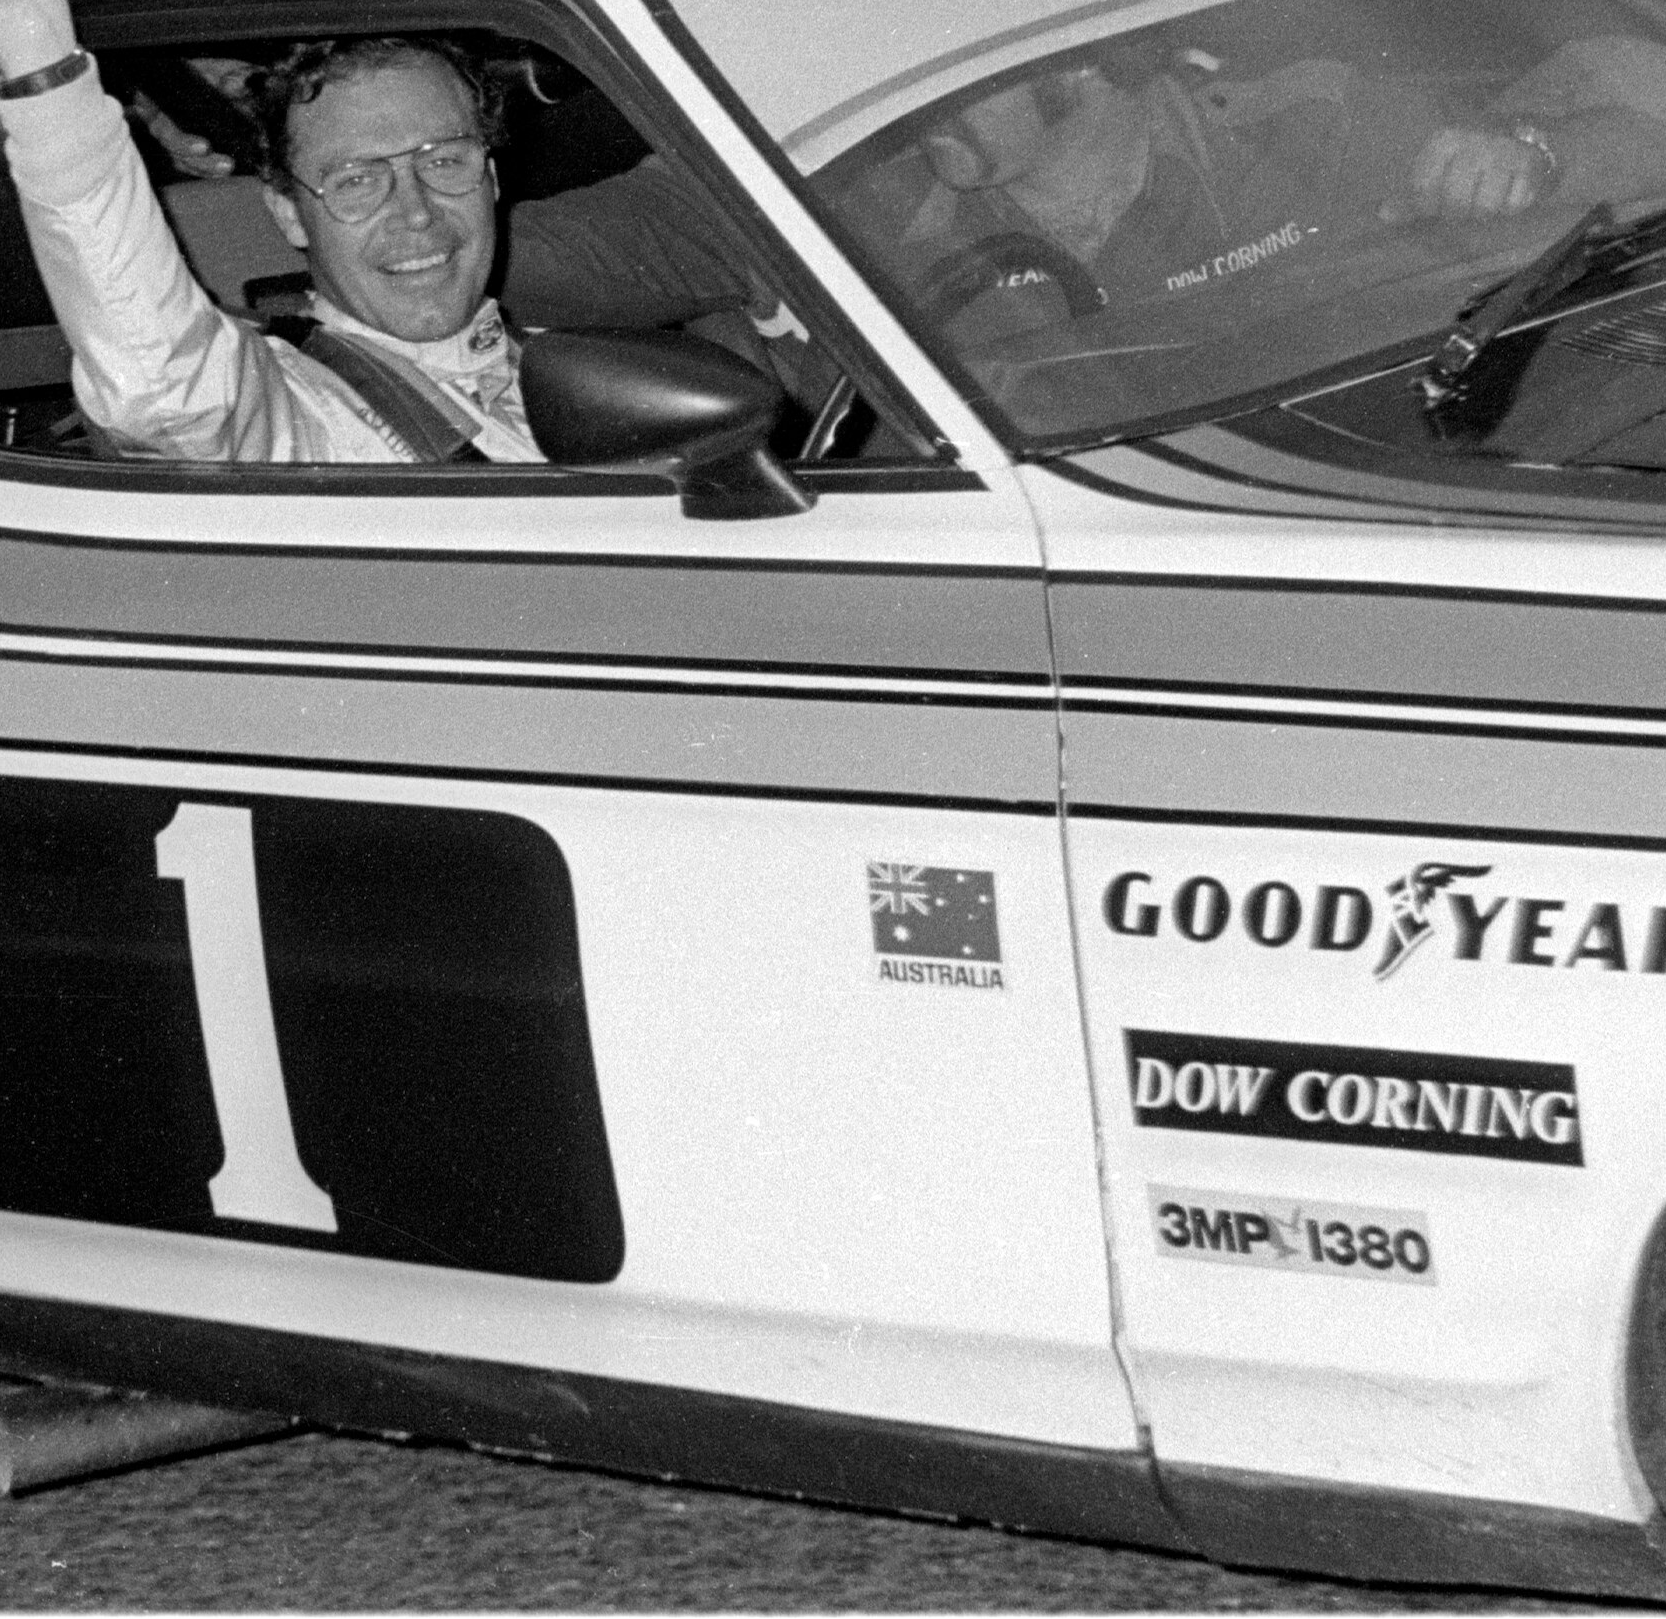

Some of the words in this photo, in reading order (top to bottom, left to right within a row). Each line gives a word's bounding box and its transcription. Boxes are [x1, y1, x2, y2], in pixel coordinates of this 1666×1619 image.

[879, 959, 1004, 990] AUSTRALIA
[155, 801, 338, 1232] 1
[1133, 1056, 1276, 1117] DOW
[1287, 1068, 1579, 1145] CORNING
[1156, 1201, 1271, 1255] 3MP
[1304, 1217, 1433, 1275] 1380
